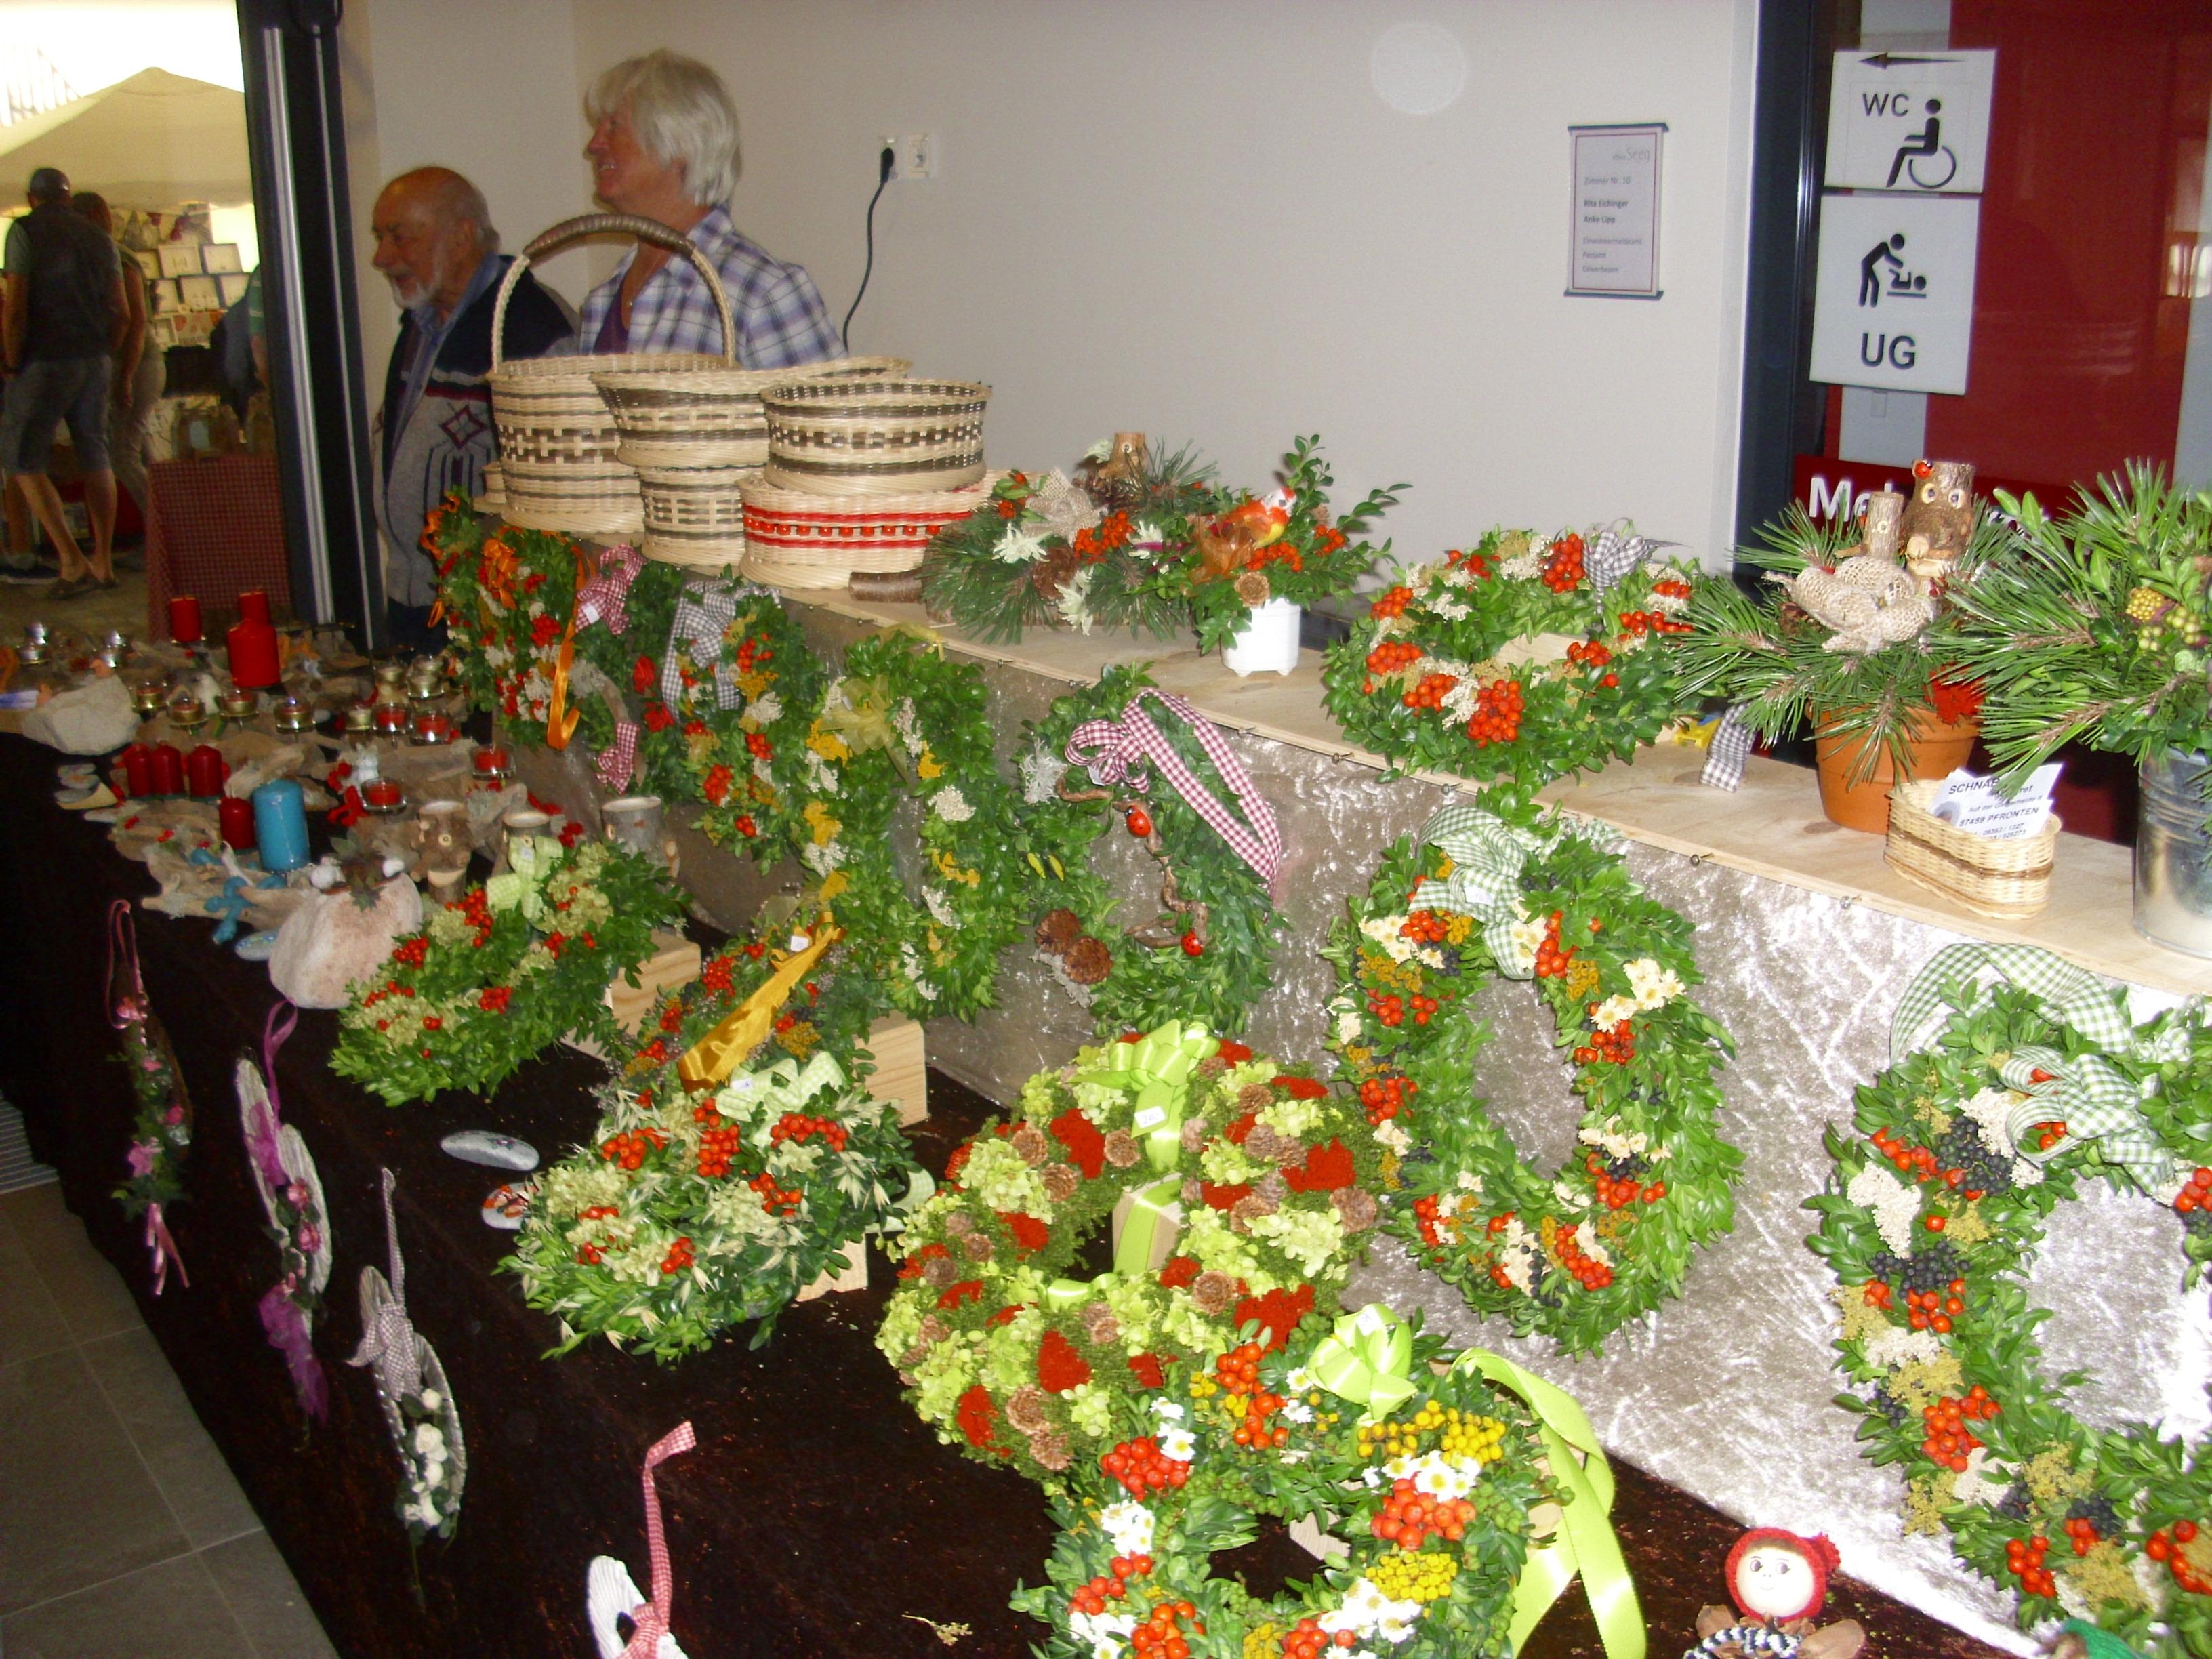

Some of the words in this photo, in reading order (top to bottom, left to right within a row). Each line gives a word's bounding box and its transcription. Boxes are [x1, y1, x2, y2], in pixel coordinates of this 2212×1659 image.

[1862, 93, 1909, 117] WC
[1626, 147, 1650, 163] Seeg
[1584, 177, 1609, 185] Zimmer
[1622, 176, 1631, 184] 10
[1584, 199, 1597, 207] Rita
[1598, 199, 1629, 209] Eichinger
[1601, 216, 1616, 225] Lipp
[1861, 332, 1916, 370] UG
[1986, 807, 2039, 823] PFRONTEN
